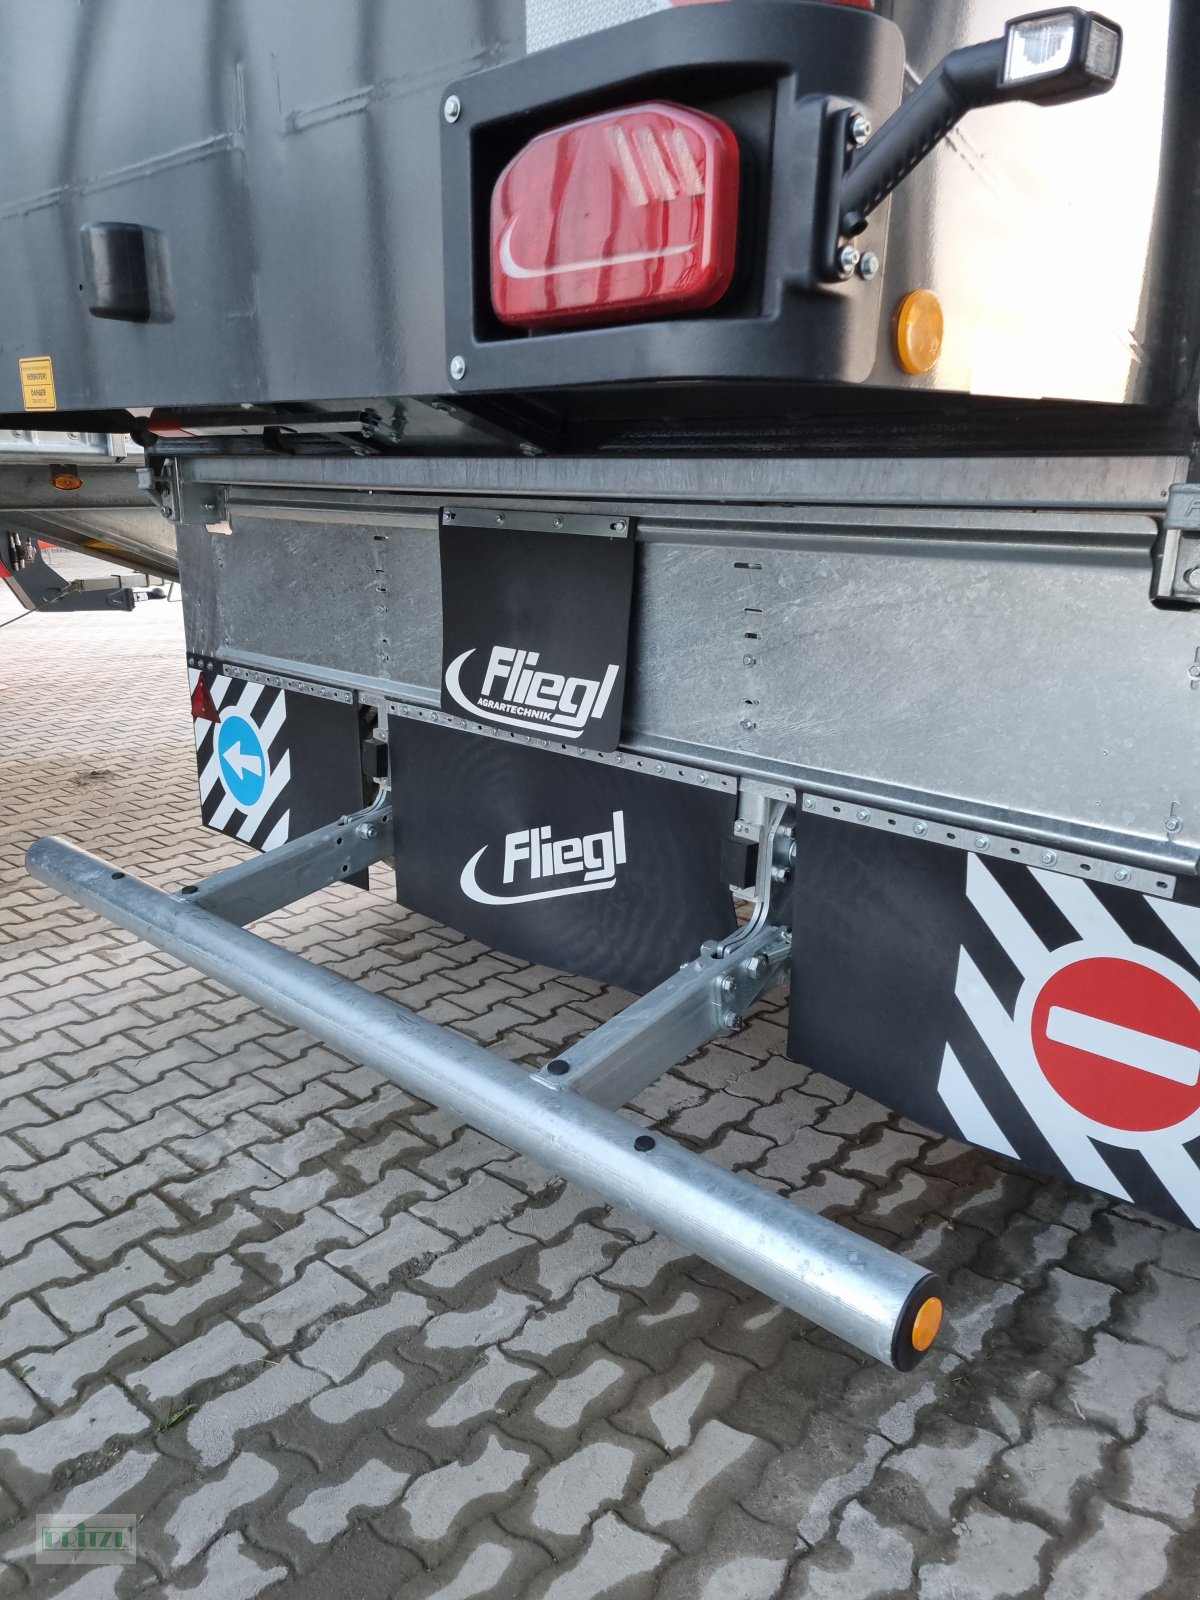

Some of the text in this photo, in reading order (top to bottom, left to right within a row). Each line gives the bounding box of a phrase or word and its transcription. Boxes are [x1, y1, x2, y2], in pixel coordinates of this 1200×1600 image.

[477, 697, 553, 722] AGRARTECHNIK
[481, 645, 620, 728] Fliegl
[503, 810, 627, 884] Fliegl
